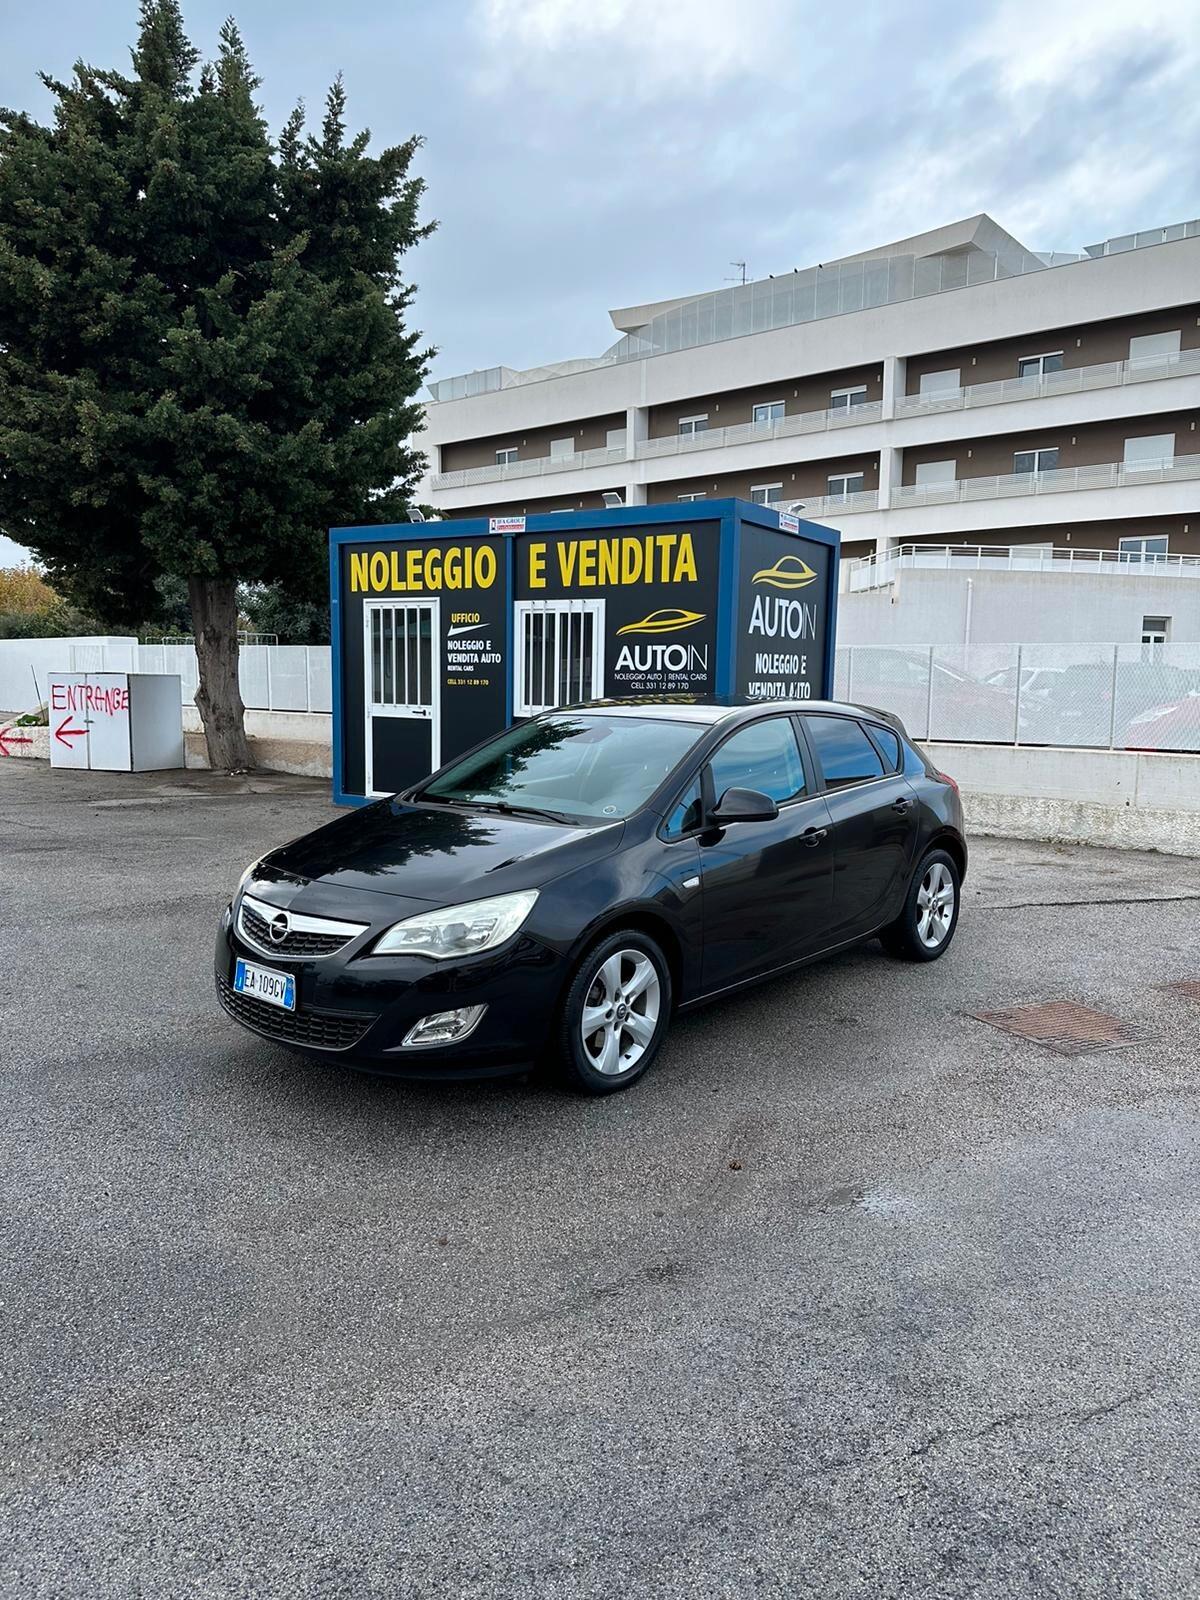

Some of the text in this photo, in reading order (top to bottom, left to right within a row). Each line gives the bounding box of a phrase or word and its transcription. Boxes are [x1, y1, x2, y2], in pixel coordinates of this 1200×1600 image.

[351, 533, 698, 592] NOLEGGIO E VENDITA
[451, 613, 480, 623] UFFICIO
[748, 594, 816, 640] AUTOIN
[447, 640, 492, 650] NOLEGGIO E
[447, 653, 502, 663] VENDITA AUTO
[615, 644, 708, 671] AUTOIN
[755, 653, 807, 674] NOLEGGIO E
[748, 682, 786, 697] VENDITA
[244, 969, 255, 990] EA
